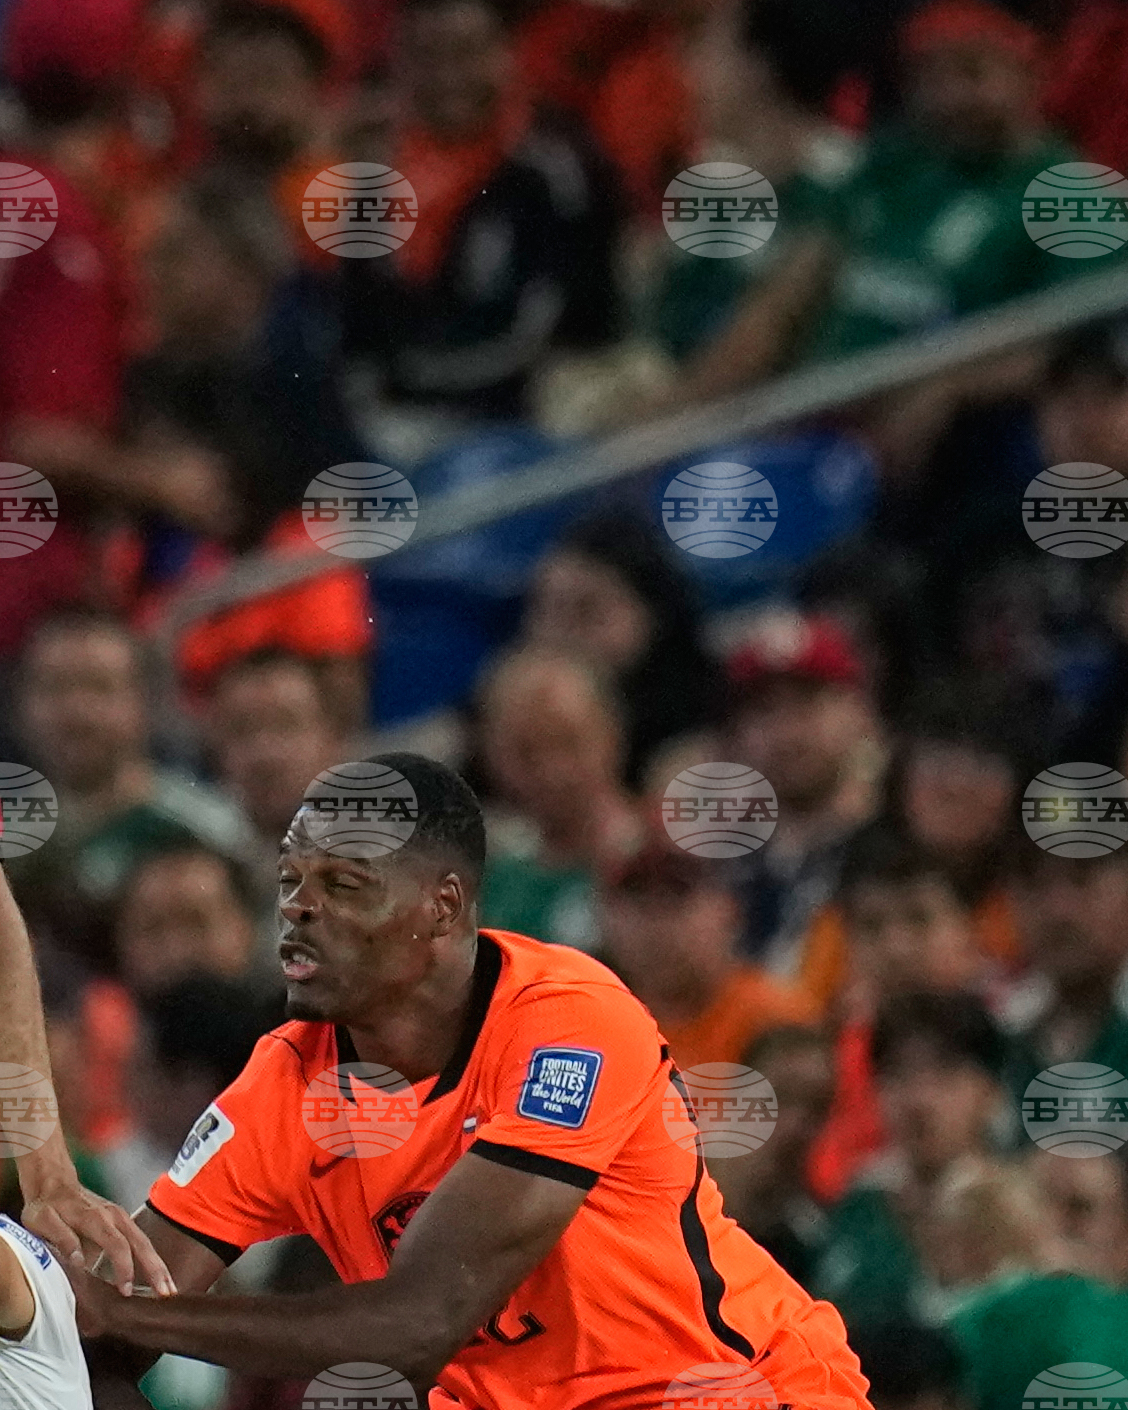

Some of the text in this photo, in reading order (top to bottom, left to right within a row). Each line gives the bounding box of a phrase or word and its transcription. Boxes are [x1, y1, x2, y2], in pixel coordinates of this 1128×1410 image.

[542, 1057, 588, 1076] FOOTBALL
[539, 1069, 587, 1092] UNITES
[532, 1083, 585, 1109] the World
[543, 1101, 564, 1114] FIFA
